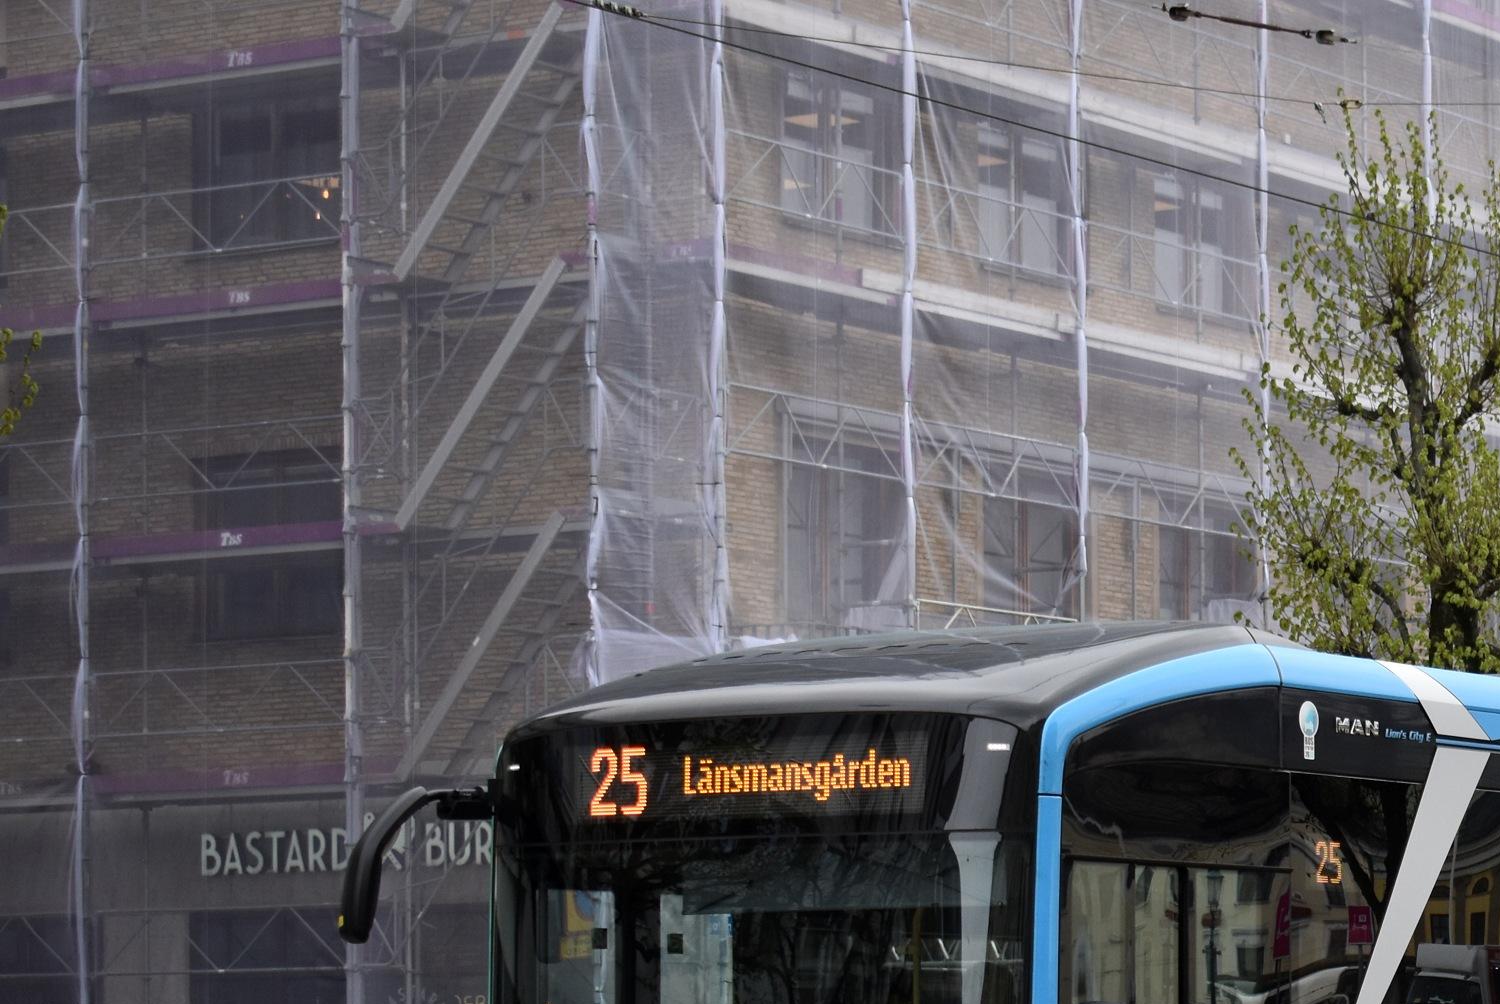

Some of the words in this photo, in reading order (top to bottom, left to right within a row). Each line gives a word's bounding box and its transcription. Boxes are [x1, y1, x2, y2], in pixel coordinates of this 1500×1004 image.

[1336, 716, 1379, 736] MAN
[1385, 728, 1407, 740] Lion's
[591, 747, 648, 816] 25
[683, 748, 911, 800] Länsmansgården
[200, 828, 350, 876] BASTARD
[1315, 841, 1342, 884] 25
